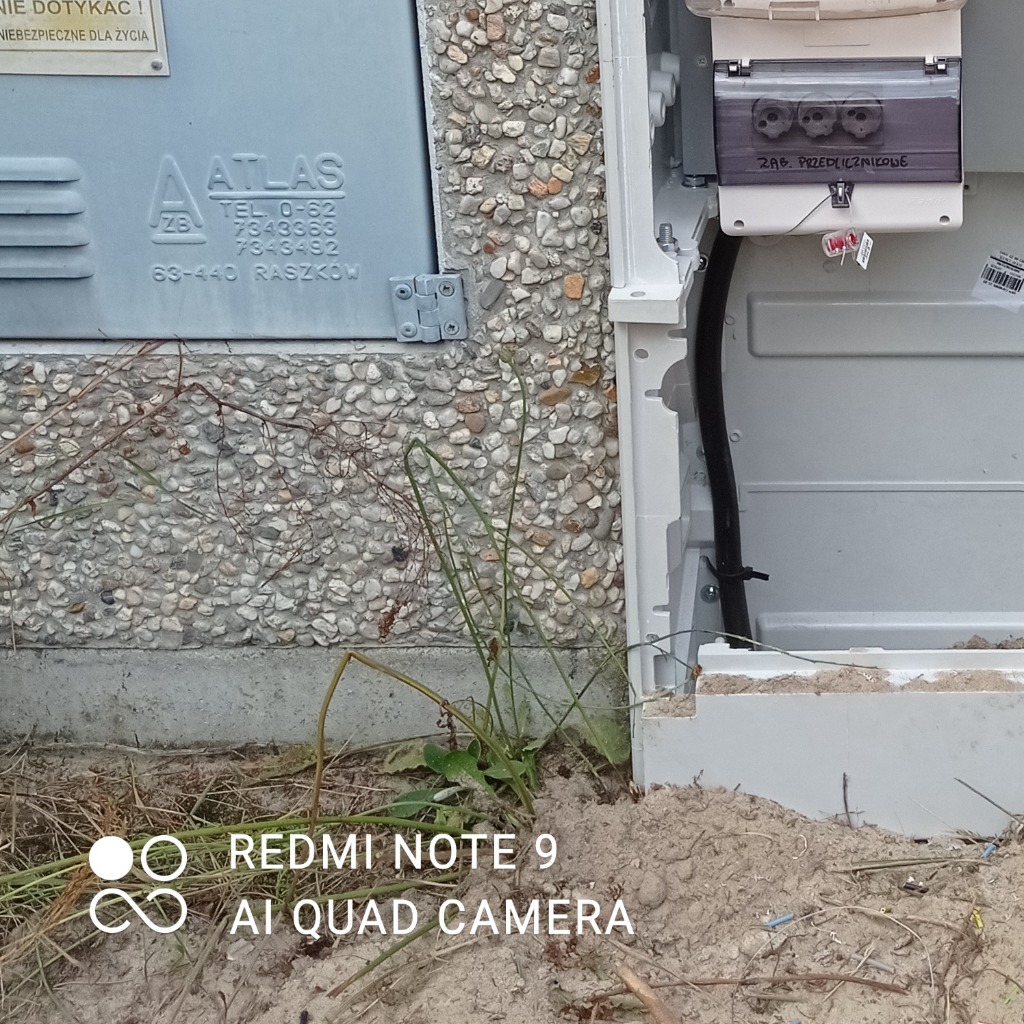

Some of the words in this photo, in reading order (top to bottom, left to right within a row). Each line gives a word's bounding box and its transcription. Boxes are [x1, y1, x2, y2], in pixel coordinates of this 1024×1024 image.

[89, 29, 112, 41] DLA
[115, 26, 149, 42] ŻYCIA
[206, 152, 345, 191] ATLAS
[219, 199, 269, 218] TEL.
[279, 199, 337, 218] 0-62
[161, 213, 191, 233] ZB
[235, 238, 340, 256] 7343492
[152, 263, 239, 282] 63-440
